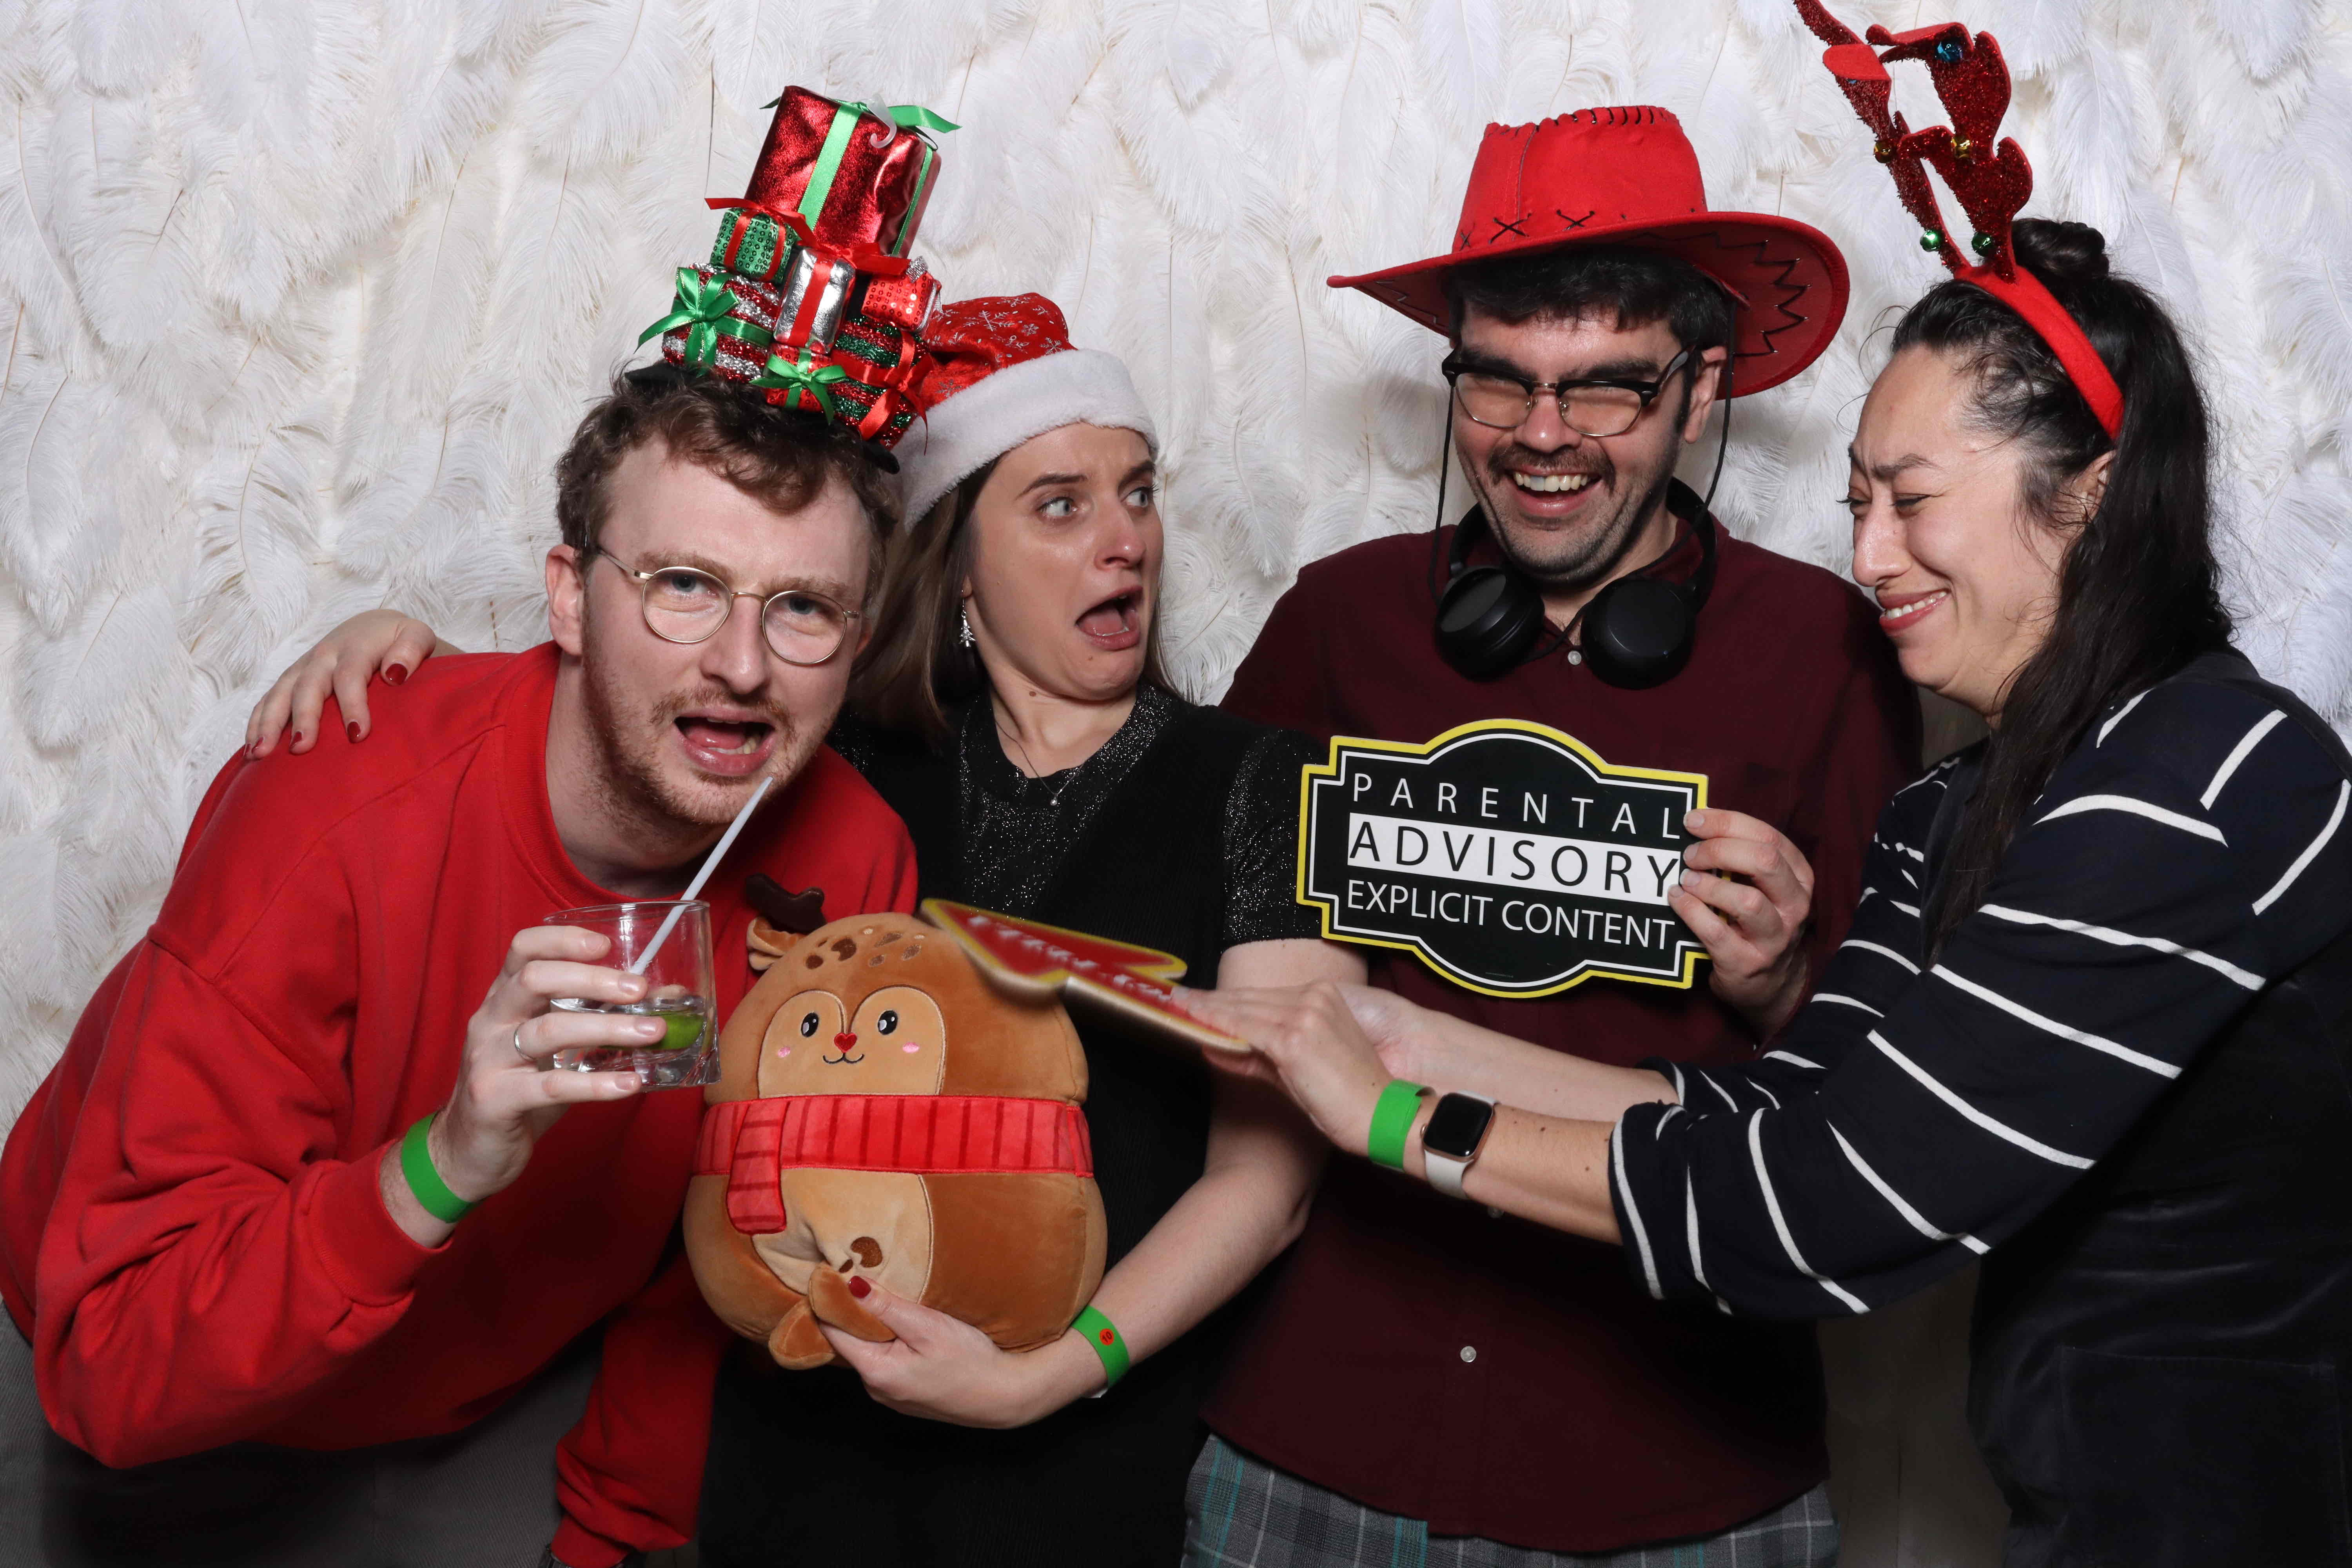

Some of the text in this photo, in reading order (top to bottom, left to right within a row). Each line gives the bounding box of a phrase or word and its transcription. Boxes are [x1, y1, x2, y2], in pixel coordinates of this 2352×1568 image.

[1354, 773, 1680, 839] PARENTAL
[1349, 821, 1679, 897] ADVISORY
[1348, 879, 1675, 949] EXPLICIT CONTENT
